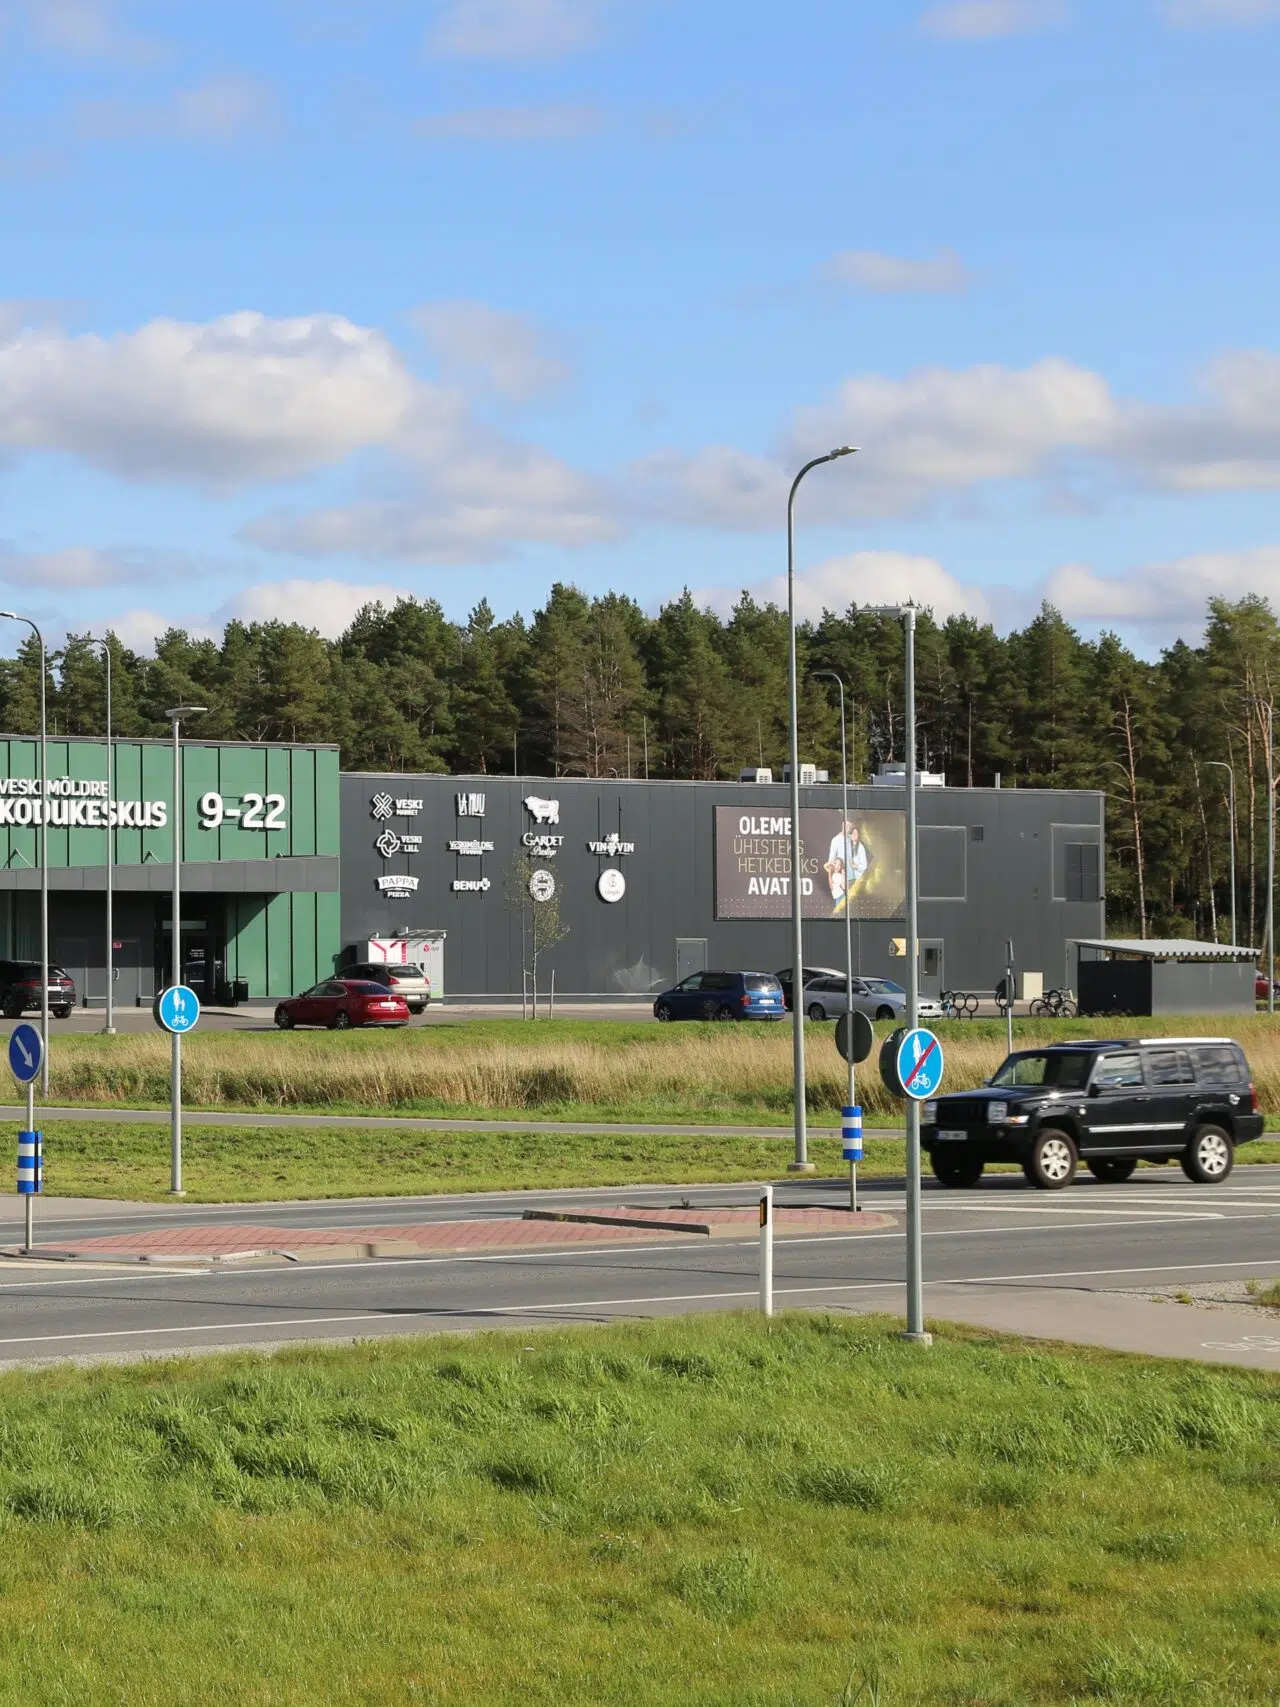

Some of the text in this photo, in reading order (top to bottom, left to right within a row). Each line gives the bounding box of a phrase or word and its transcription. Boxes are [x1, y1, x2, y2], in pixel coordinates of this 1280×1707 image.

[202, 792, 287, 828] 9-22
[395, 799, 424, 810] VESKI
[739, 816, 792, 835] OLEME
[401, 835, 423, 844] VESKI
[404, 844, 420, 853] LILL
[588, 841, 635, 853] VIN VIN
[738, 857, 819, 874] HETKEDKS
[381, 877, 415, 888] PAPPA
[453, 880, 480, 891] BENU
[748, 877, 814, 896] AVATD
